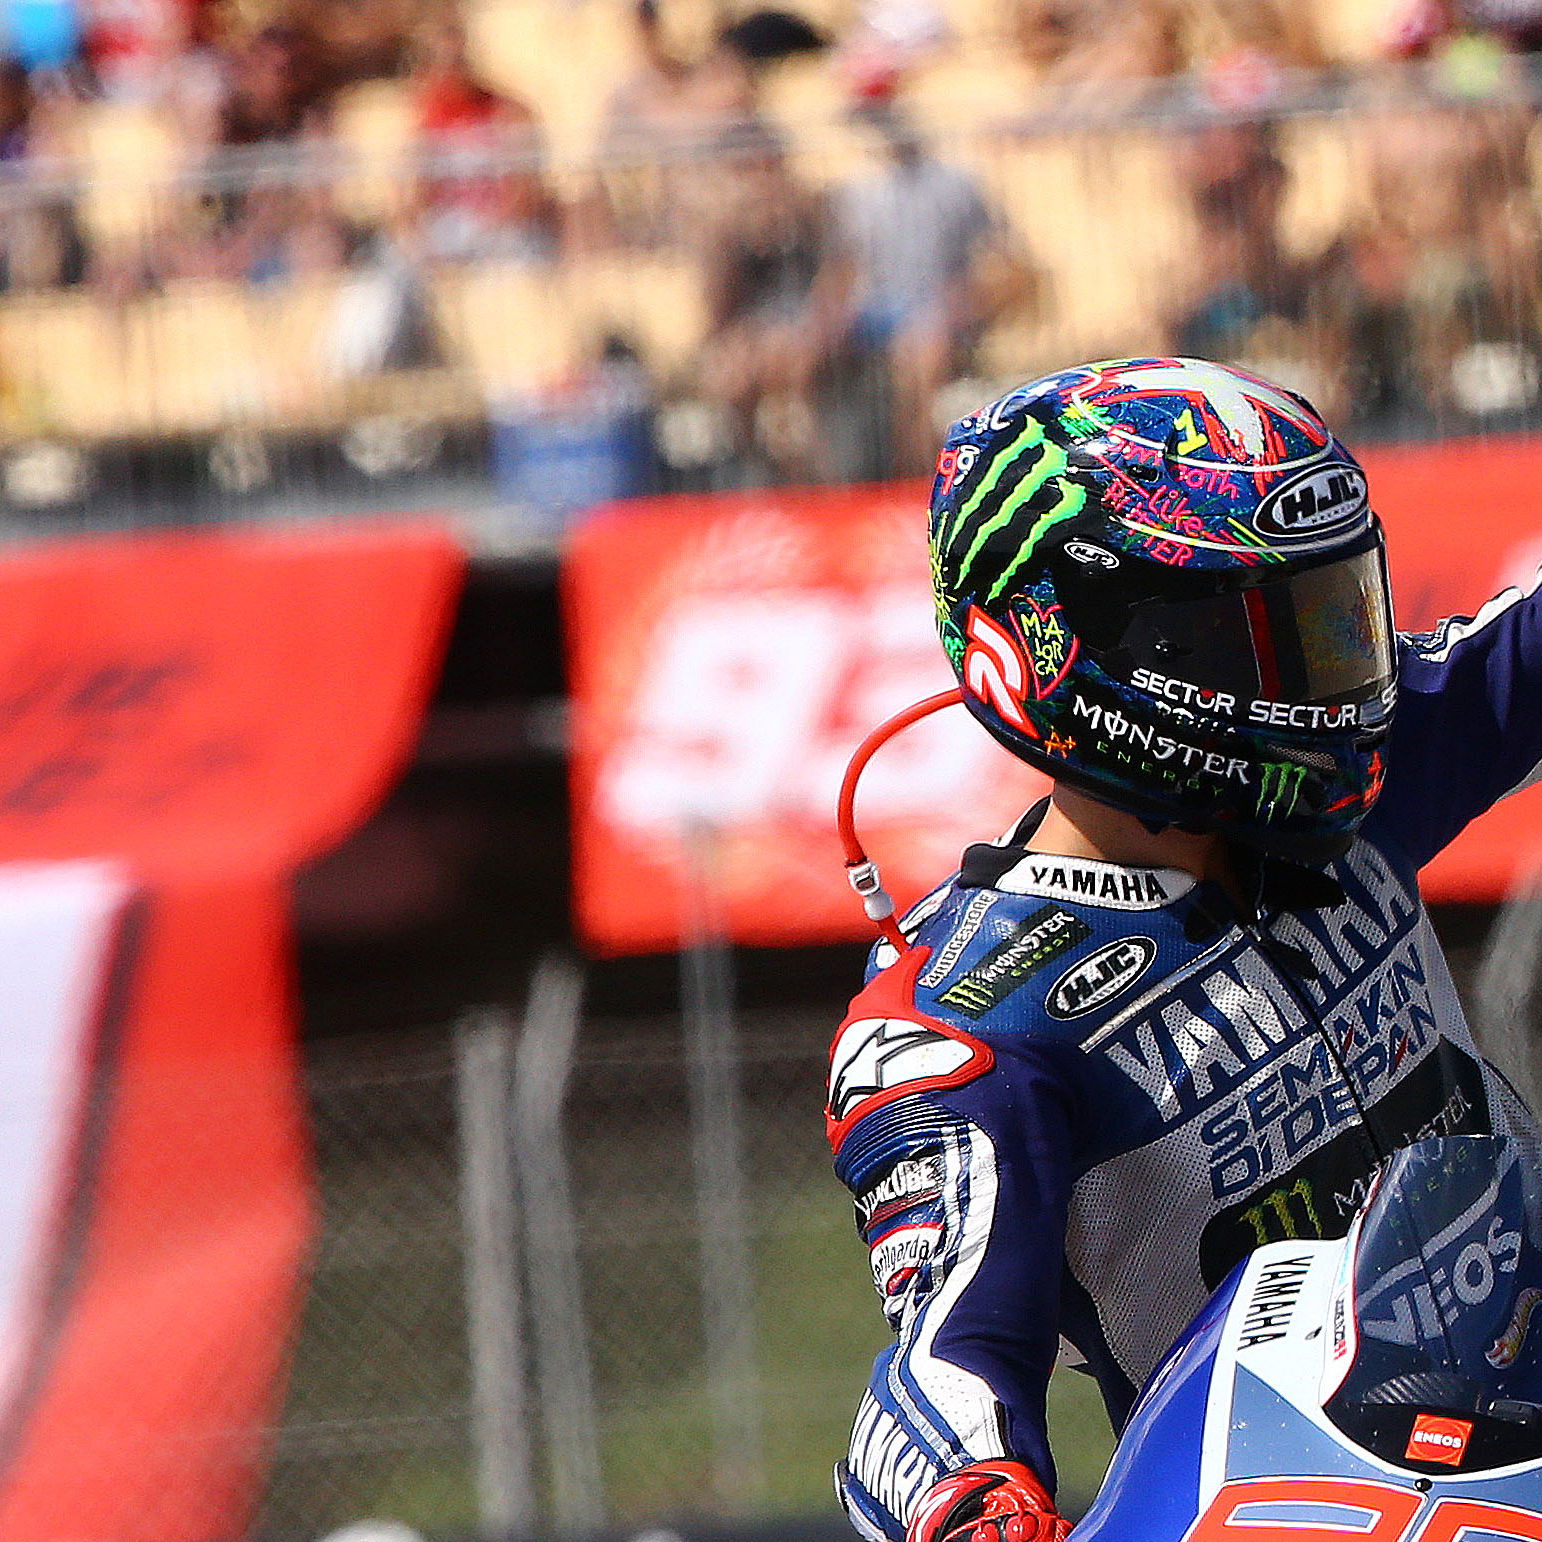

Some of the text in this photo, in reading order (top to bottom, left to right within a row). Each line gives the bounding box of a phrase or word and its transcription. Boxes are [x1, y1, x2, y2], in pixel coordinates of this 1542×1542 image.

[1130, 667, 1236, 716] SECTOR
[1249, 700, 1358, 729] SECTOR
[1072, 694, 1251, 785] MONSTER
[1096, 740, 1224, 798] ENERGY
[1030, 865, 1169, 902] YAMAHA
[981, 911, 1075, 984] MONSTER
[1060, 942, 1140, 1012] HJC
[1200, 943, 1426, 1148] SEMAKIN
[1236, 1254, 1315, 1352] YAMAHA
[1413, 1429, 1463, 1449] ENEOS
